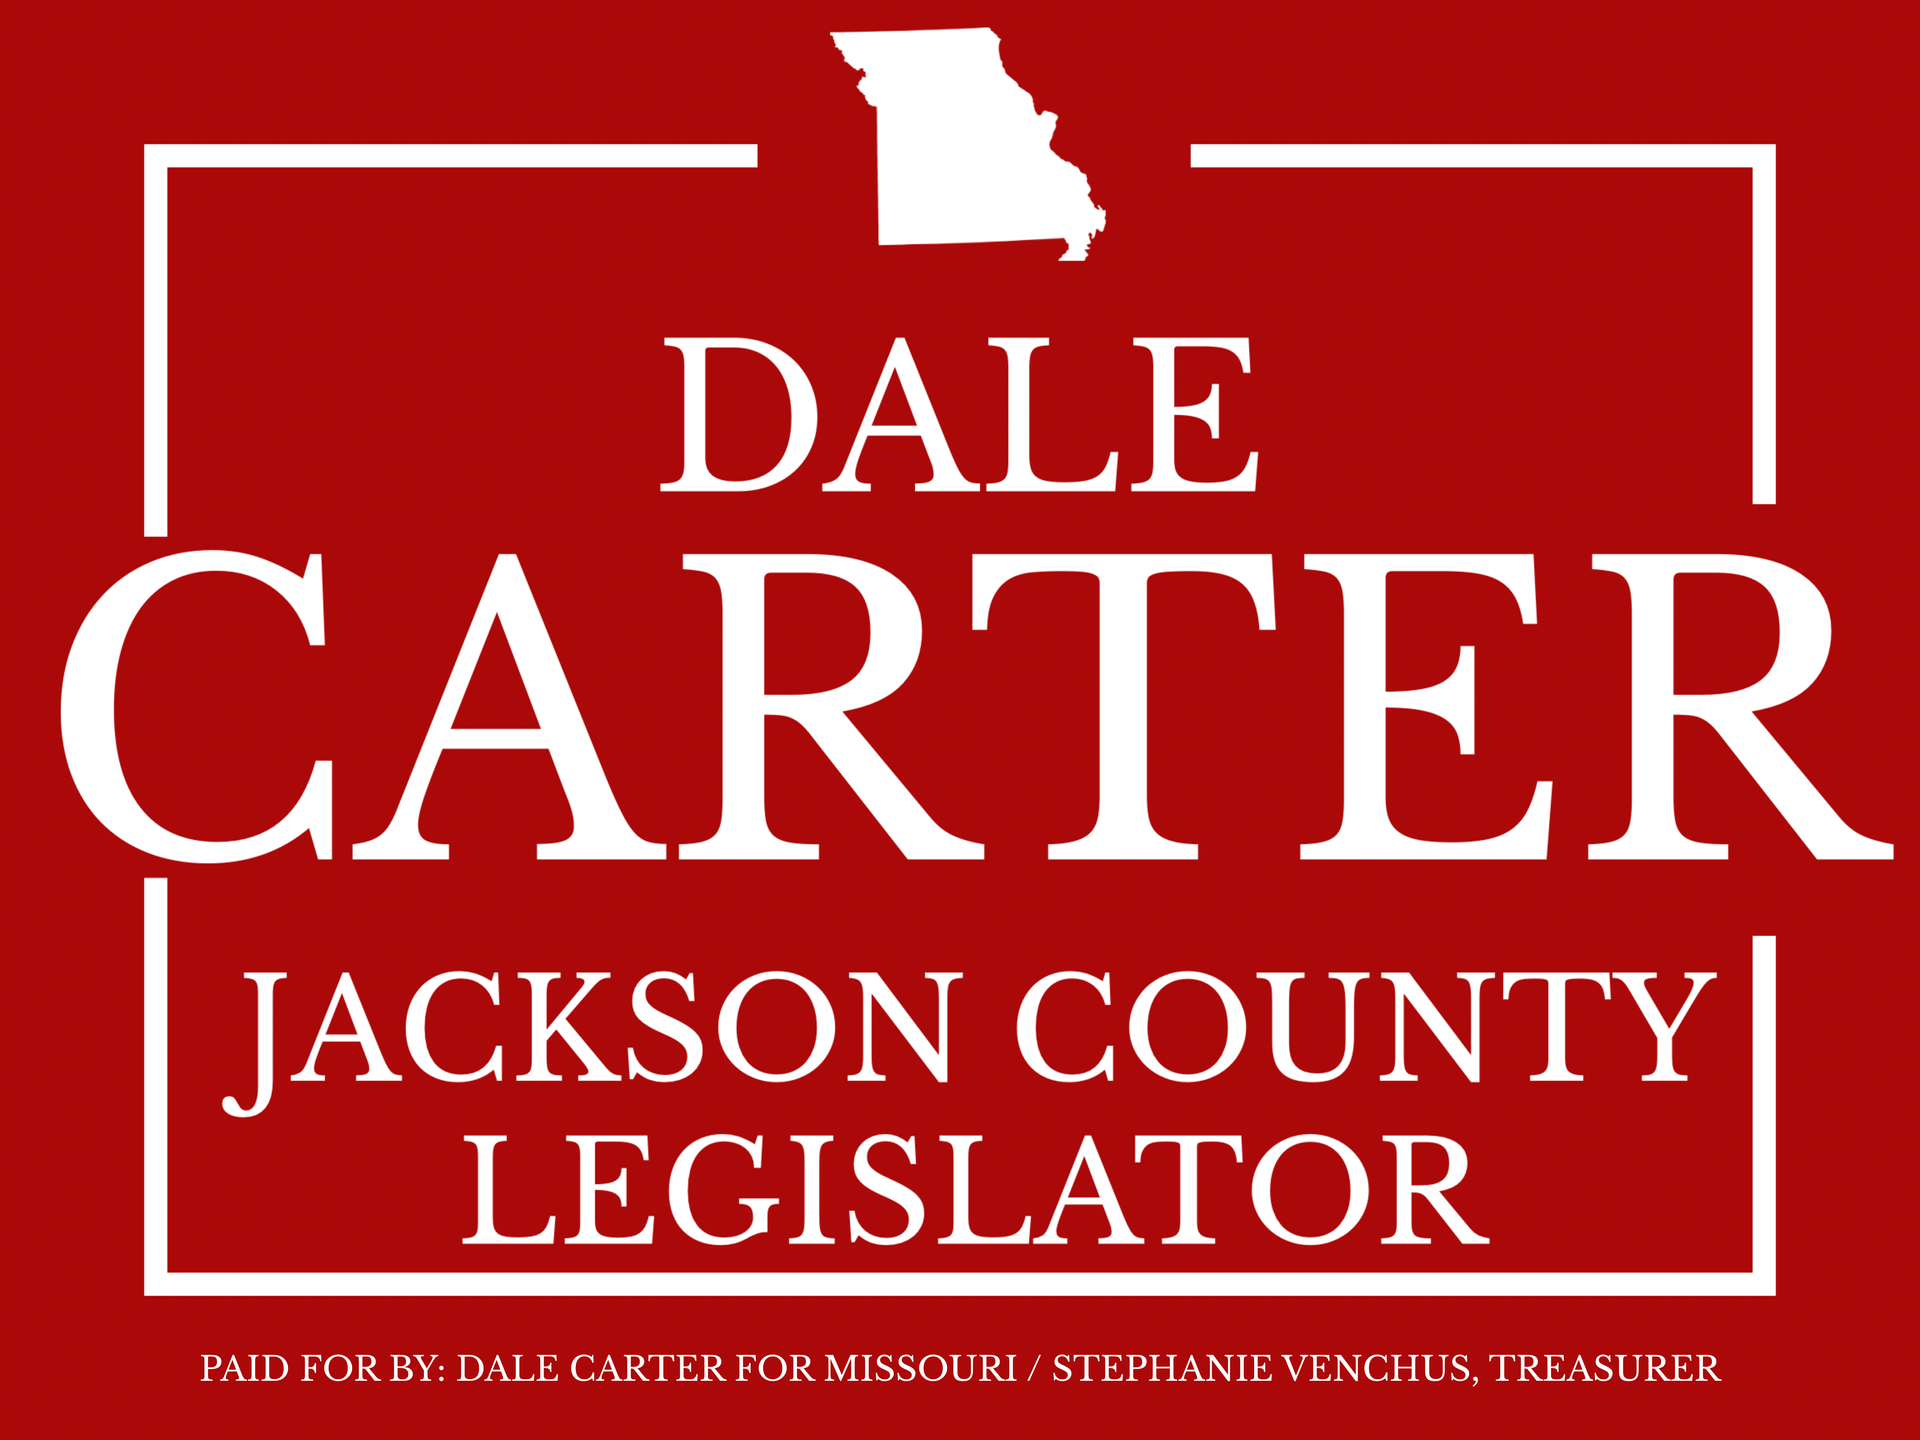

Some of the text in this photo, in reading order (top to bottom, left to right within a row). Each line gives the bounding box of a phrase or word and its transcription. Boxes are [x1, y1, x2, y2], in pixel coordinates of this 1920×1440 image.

[660, 337, 1258, 492] DALE
[60, 549, 1895, 864] CARTER
[221, 971, 1718, 1118] JACKSON COUNTY
[461, 1134, 1491, 1246] LEGISLATOR
[200, 1354, 1723, 1388] PAID FOR BY: DALE CARTER FOR MISSOURI / STEPHANIE VENCHUS, TREASURER
